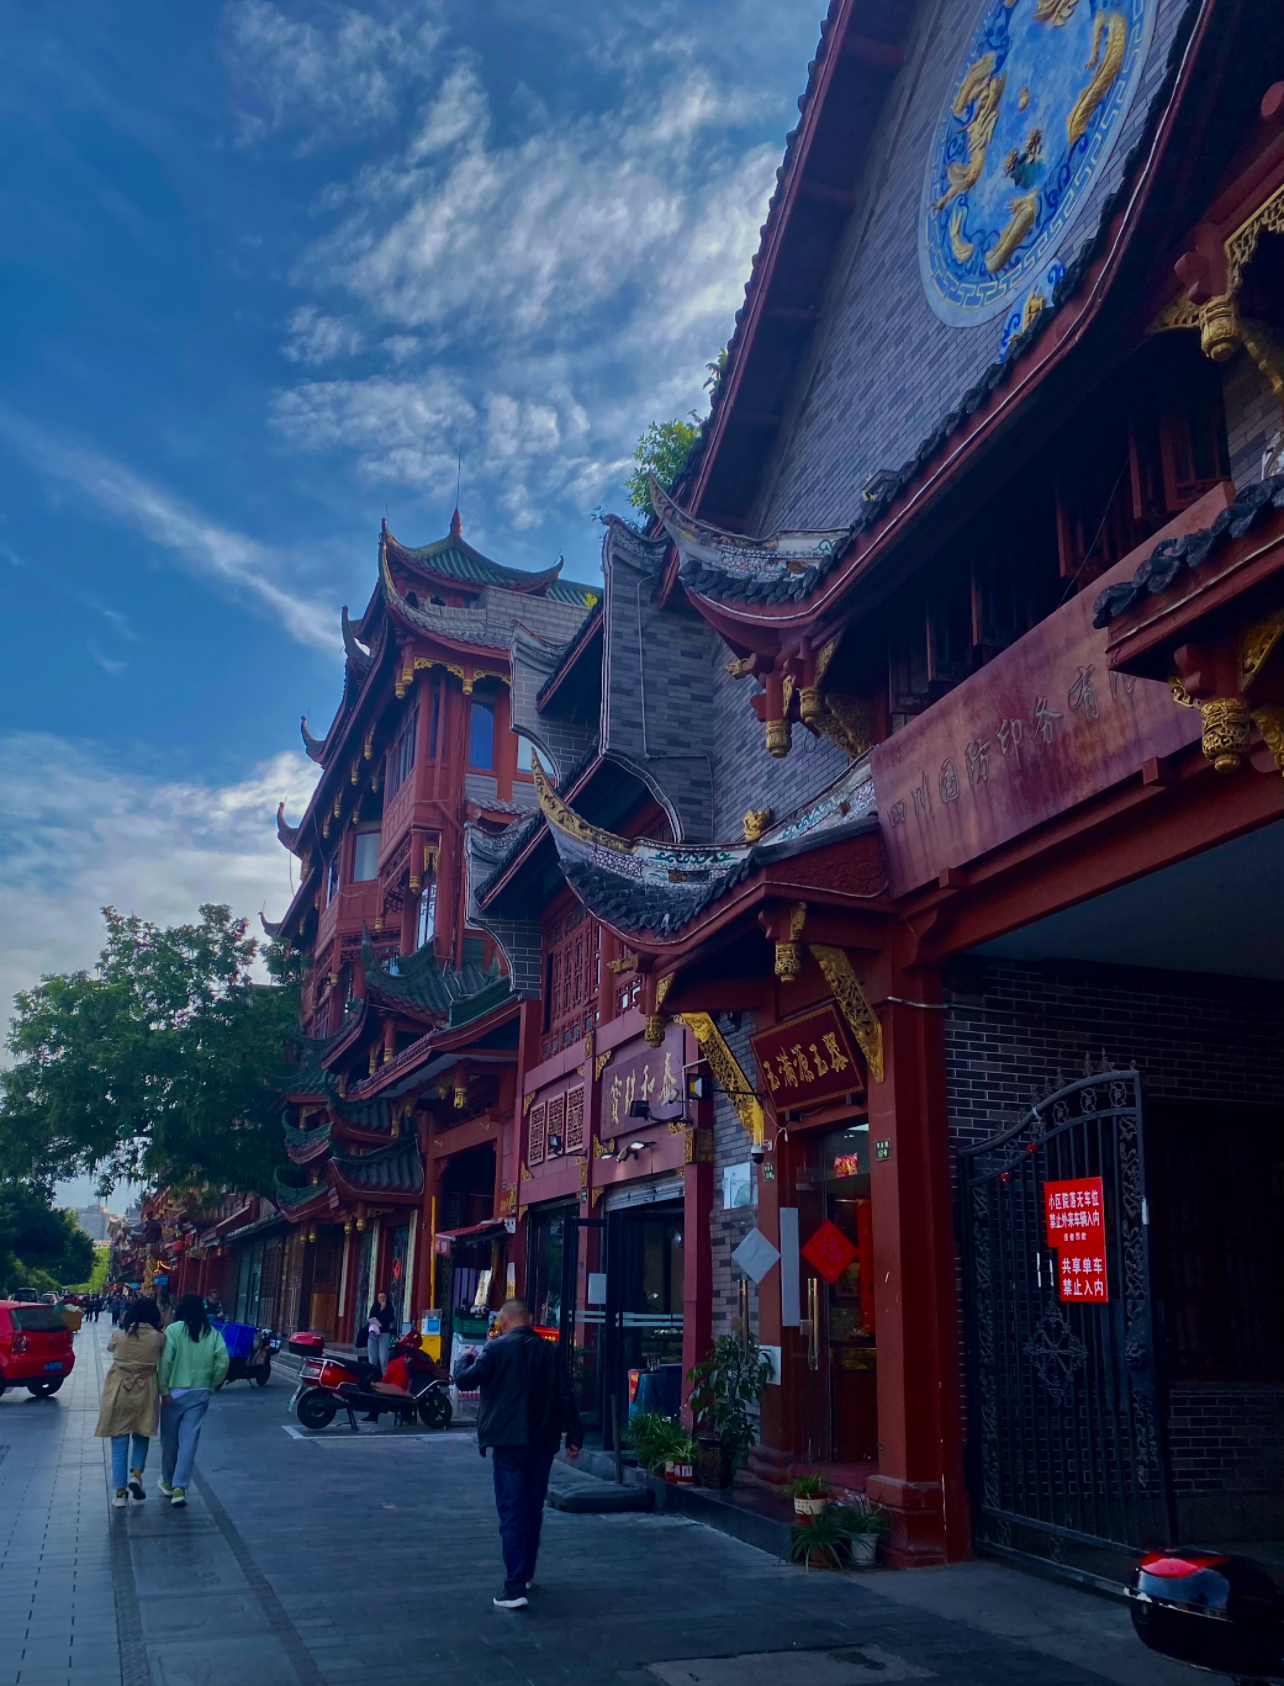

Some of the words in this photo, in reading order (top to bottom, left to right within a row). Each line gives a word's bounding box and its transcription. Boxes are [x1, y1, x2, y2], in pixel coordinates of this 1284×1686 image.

[1048, 1190, 1099, 1210] 小区院落无车位
[1049, 1208, 1100, 1229] 禁止外来车辆入内
[1062, 1257, 1103, 1274] 共享单车
[1062, 1278, 1104, 1297] 禁止入内
